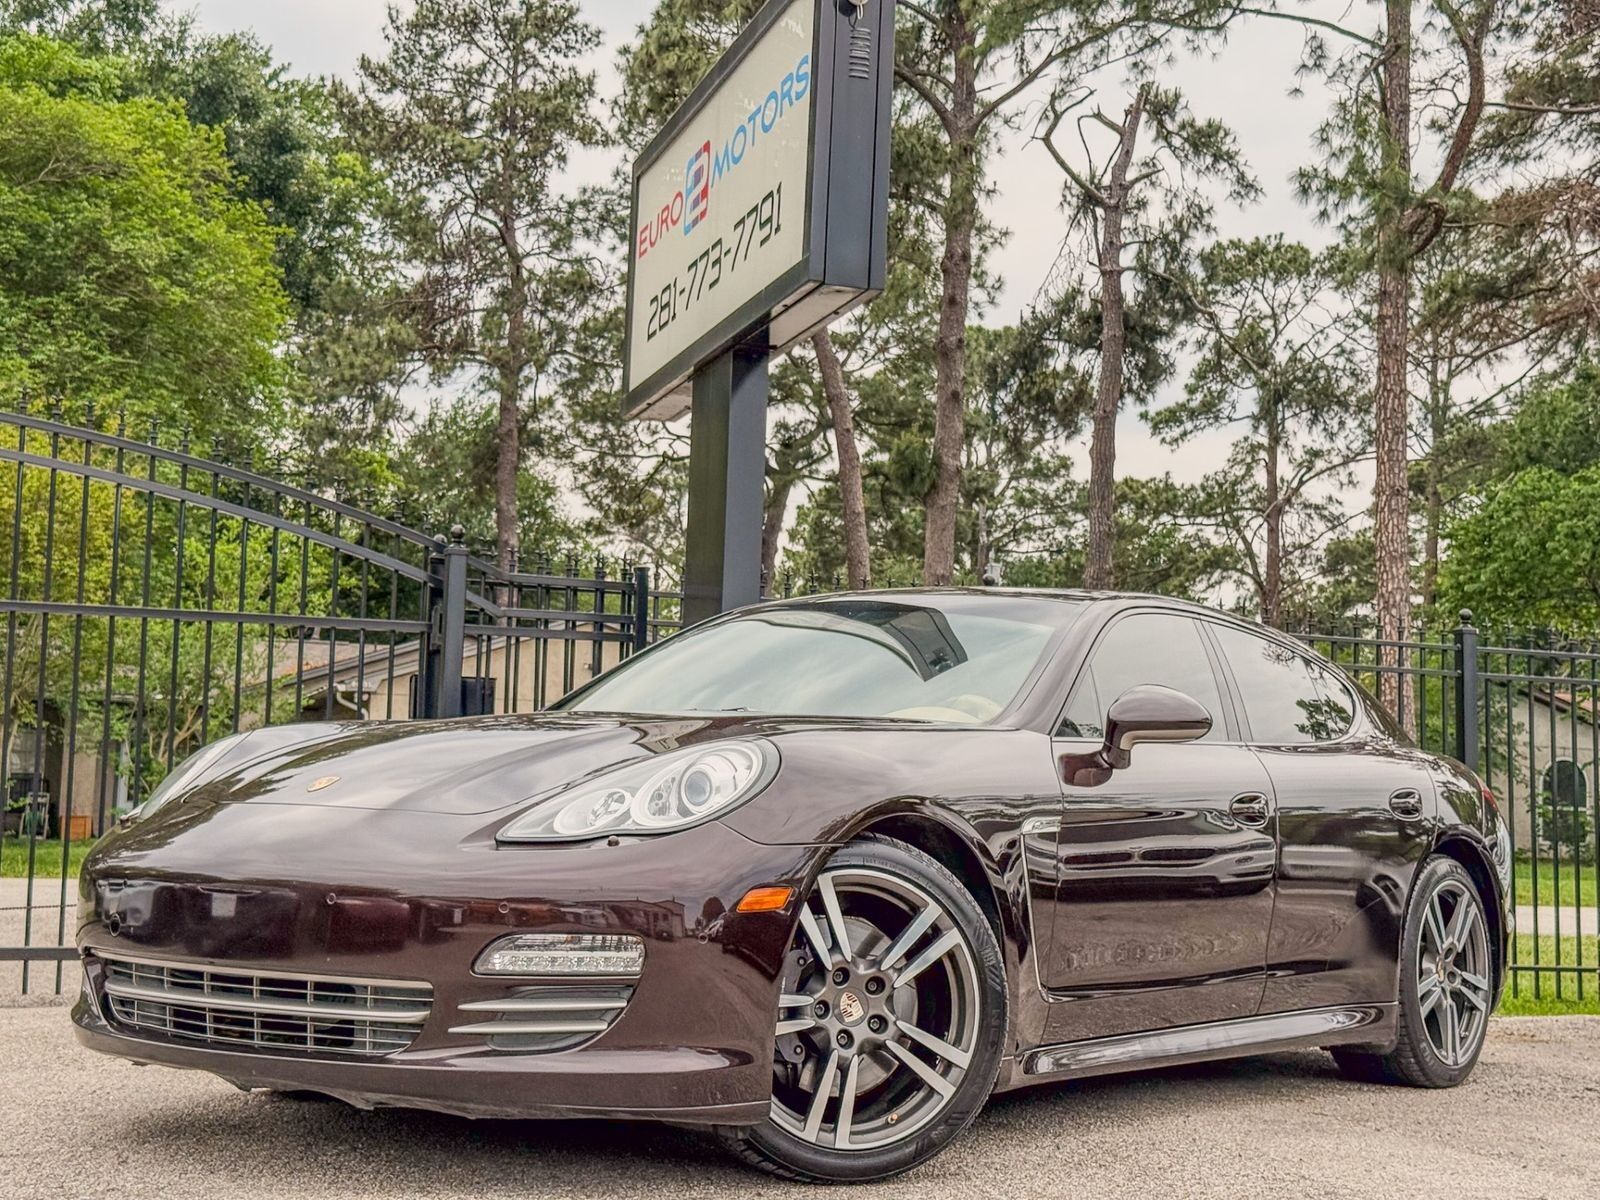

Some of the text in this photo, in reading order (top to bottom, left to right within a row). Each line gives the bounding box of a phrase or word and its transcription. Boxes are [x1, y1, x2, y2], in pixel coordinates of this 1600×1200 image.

[638, 54, 809, 259] EURO MOTORS
[647, 181, 782, 342] 281-773-7791
